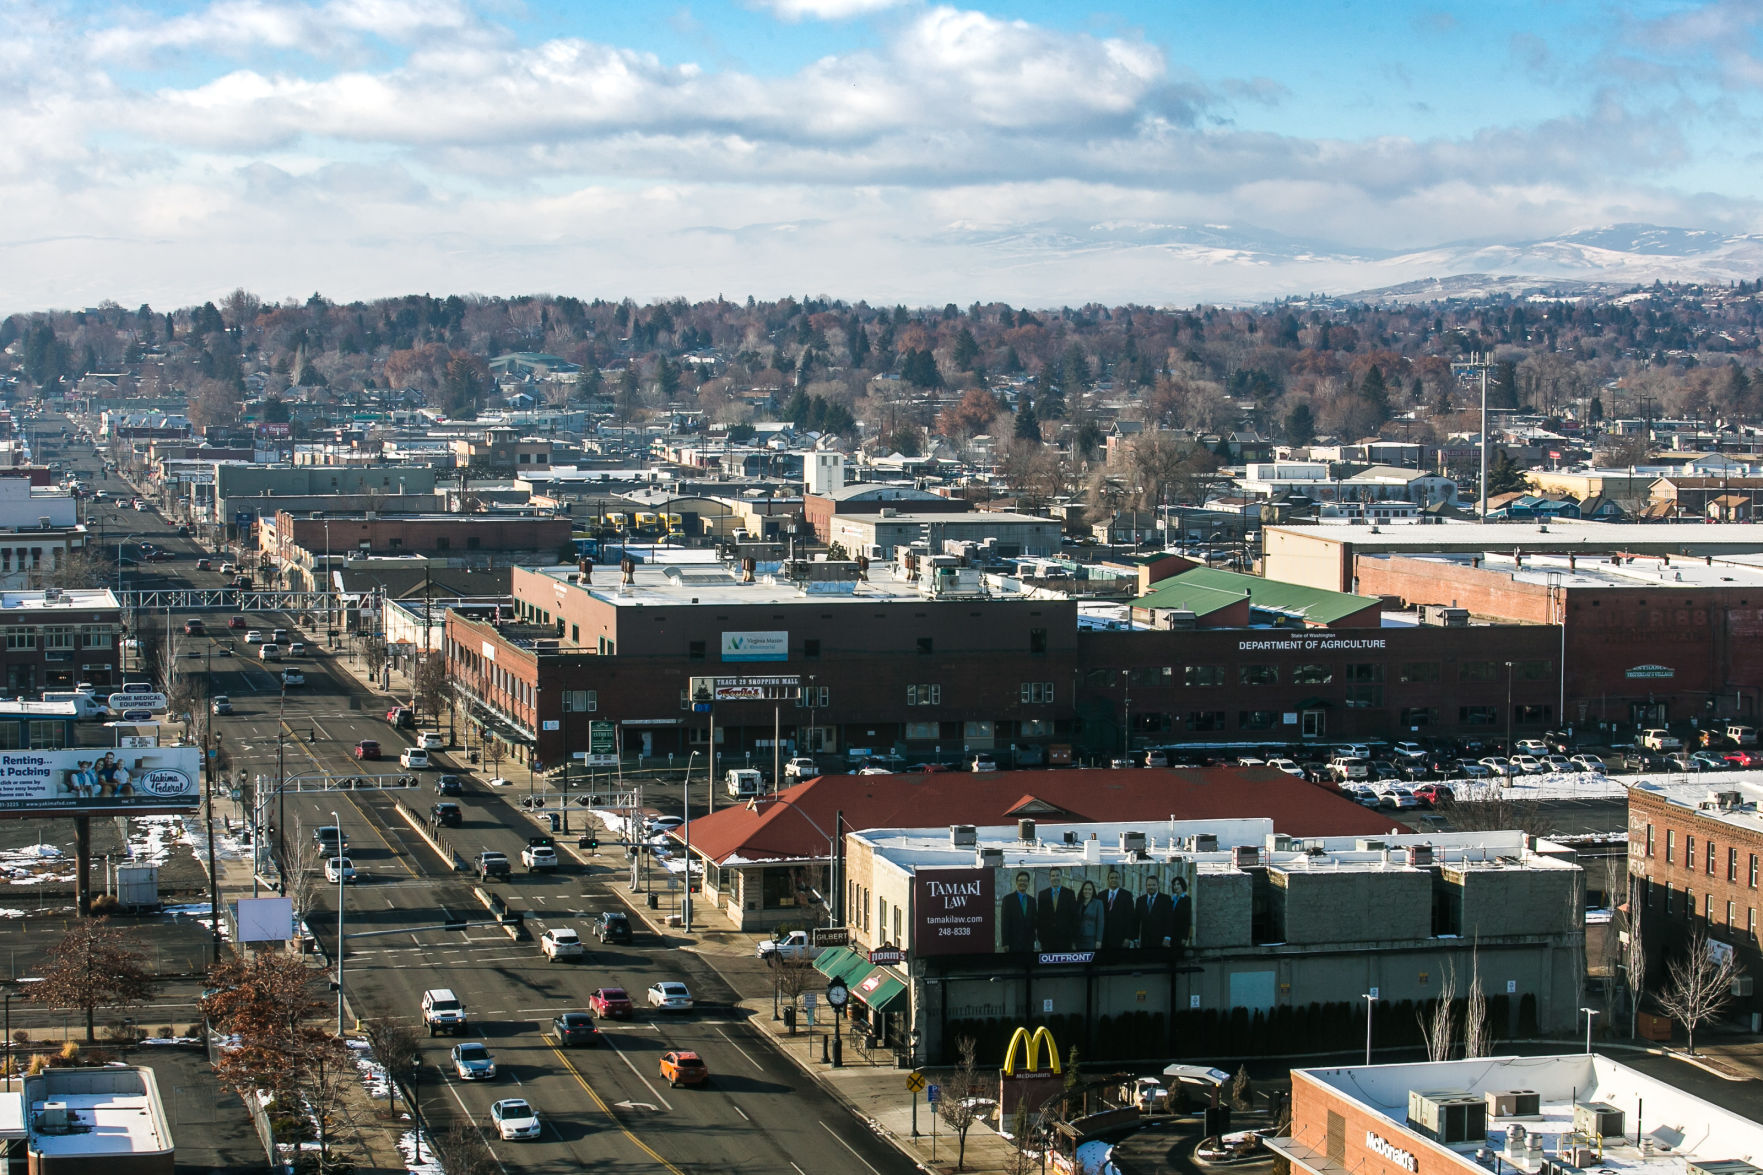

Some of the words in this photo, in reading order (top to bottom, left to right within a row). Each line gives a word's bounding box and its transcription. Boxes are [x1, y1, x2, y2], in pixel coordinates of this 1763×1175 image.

[1239, 641, 1303, 650] DEPARTMENT
[1305, 641, 1318, 649] OF
[1320, 639, 1386, 649] AGRICULTURE
[3, 755, 53, 766] Renting...
[7, 767, 51, 777] Packing
[149, 772, 179, 789] Yakima
[155, 782, 184, 793] Federal
[926, 880, 982, 897] TAMAKI
[944, 896, 968, 909] LAW
[927, 915, 983, 924] tamakilaw.com
[816, 932, 848, 941] GILBERT
[938, 927, 971, 936] 248-8338
[1041, 953, 1092, 963] OUTFRONT
[1366, 1130, 1415, 1173] McDonald's
